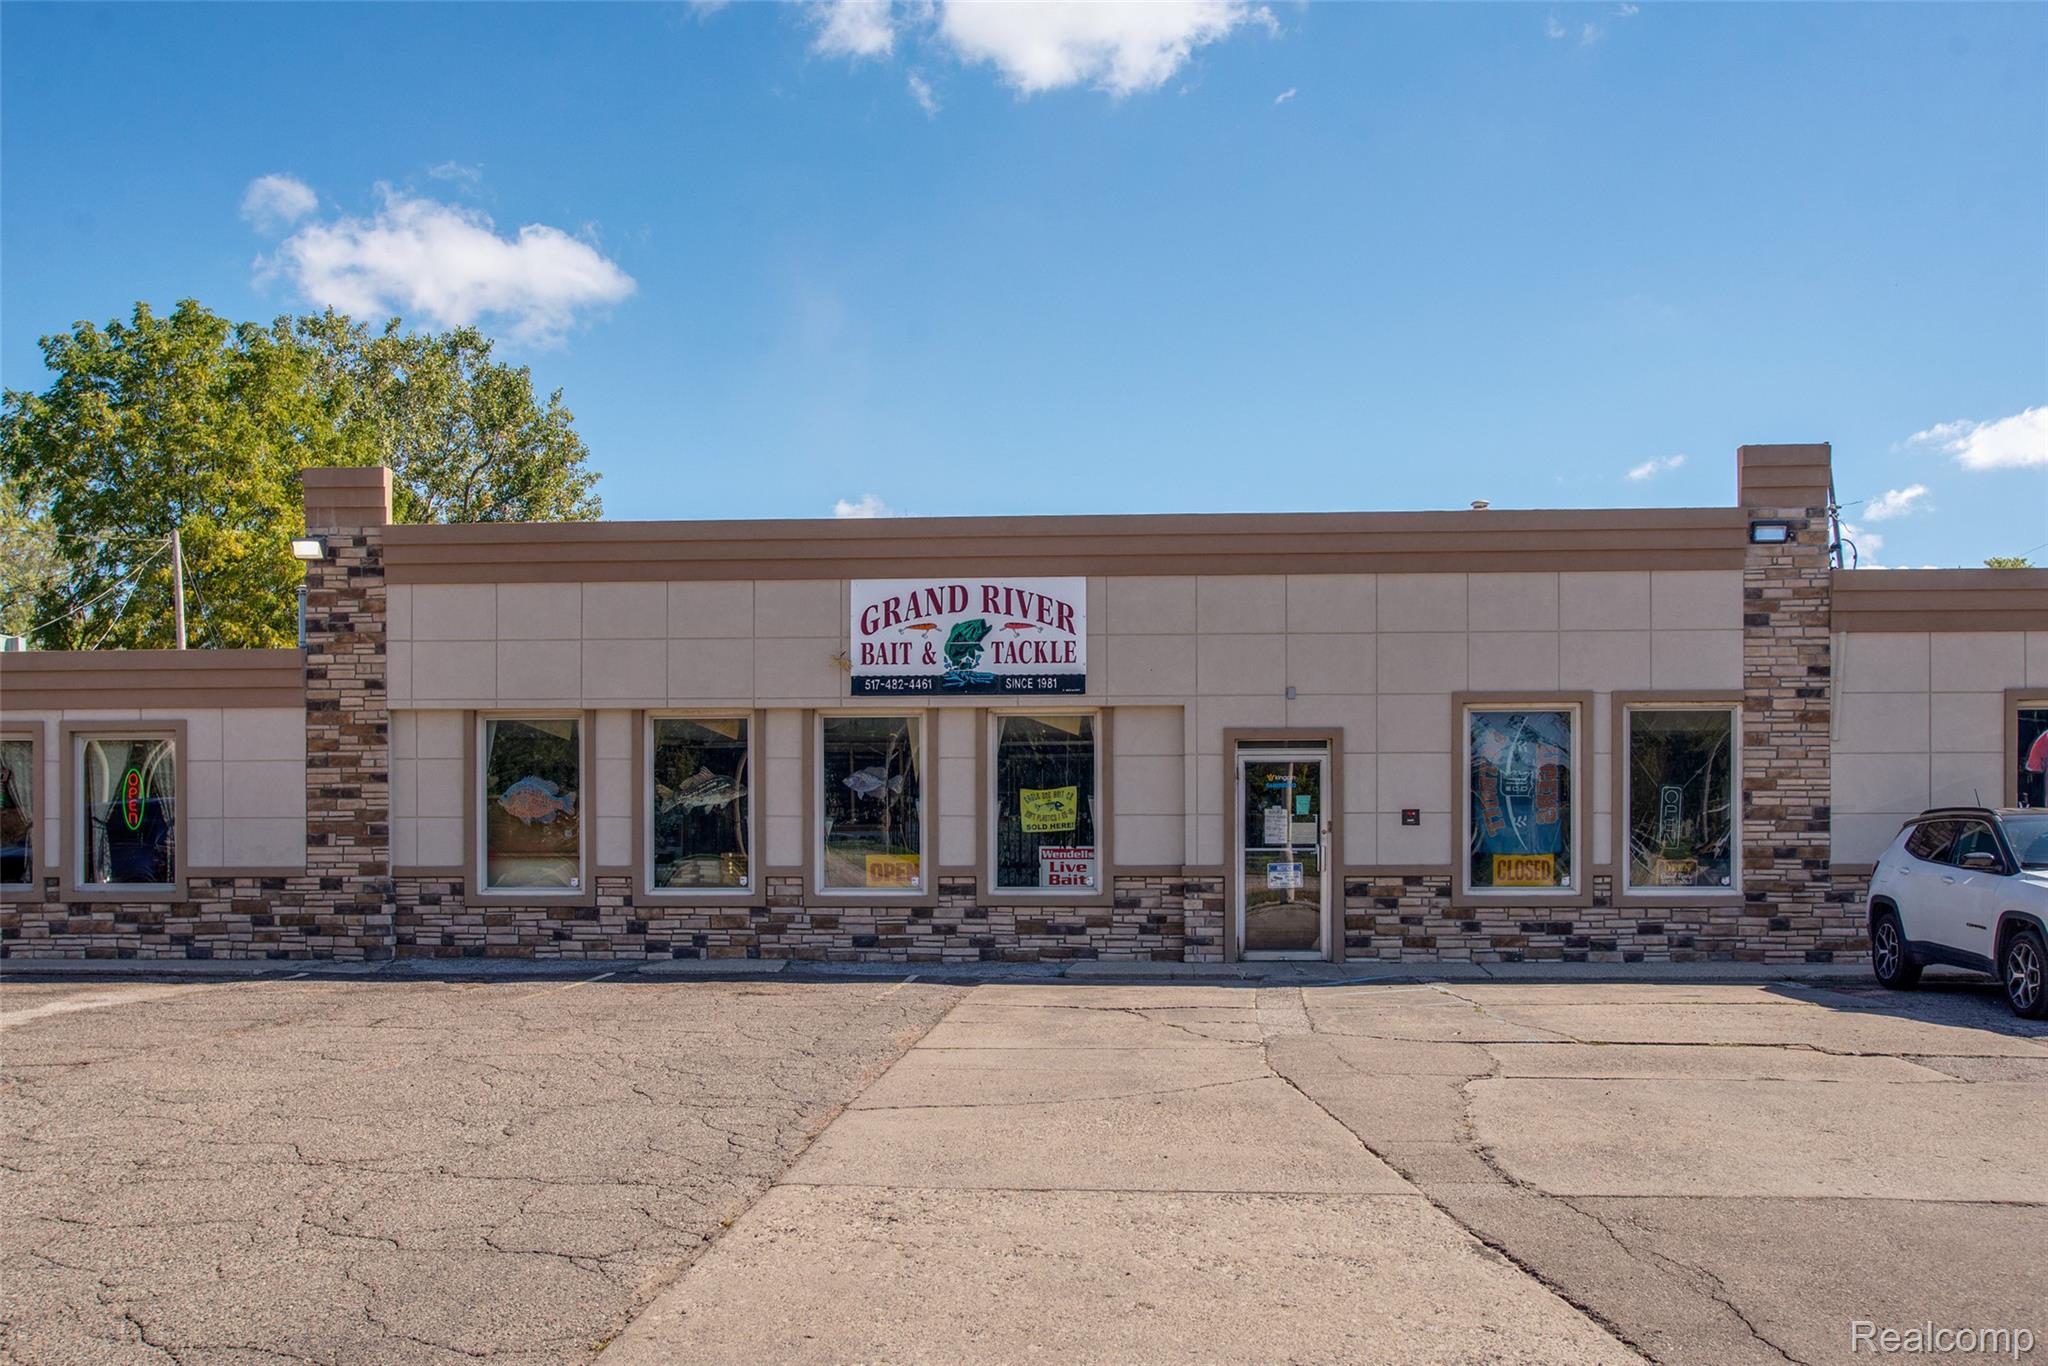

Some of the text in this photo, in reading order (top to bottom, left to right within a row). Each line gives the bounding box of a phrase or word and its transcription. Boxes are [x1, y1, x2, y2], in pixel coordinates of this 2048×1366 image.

[860, 584, 1077, 636] GRAND RIVER
[860, 640, 1077, 666] BAIT & TACKLE
[864, 677, 1058, 690] 517-482-4461 SINCE 1981
[127, 773, 139, 825] OPEN
[1026, 822, 1074, 831] SOLD HERE!
[1663, 789, 1679, 847] OPEN
[869, 862, 920, 882] OPEN
[1049, 861, 1088, 873] Live
[1496, 859, 1551, 881] CLOSED
[1049, 874, 1088, 886] Bait
